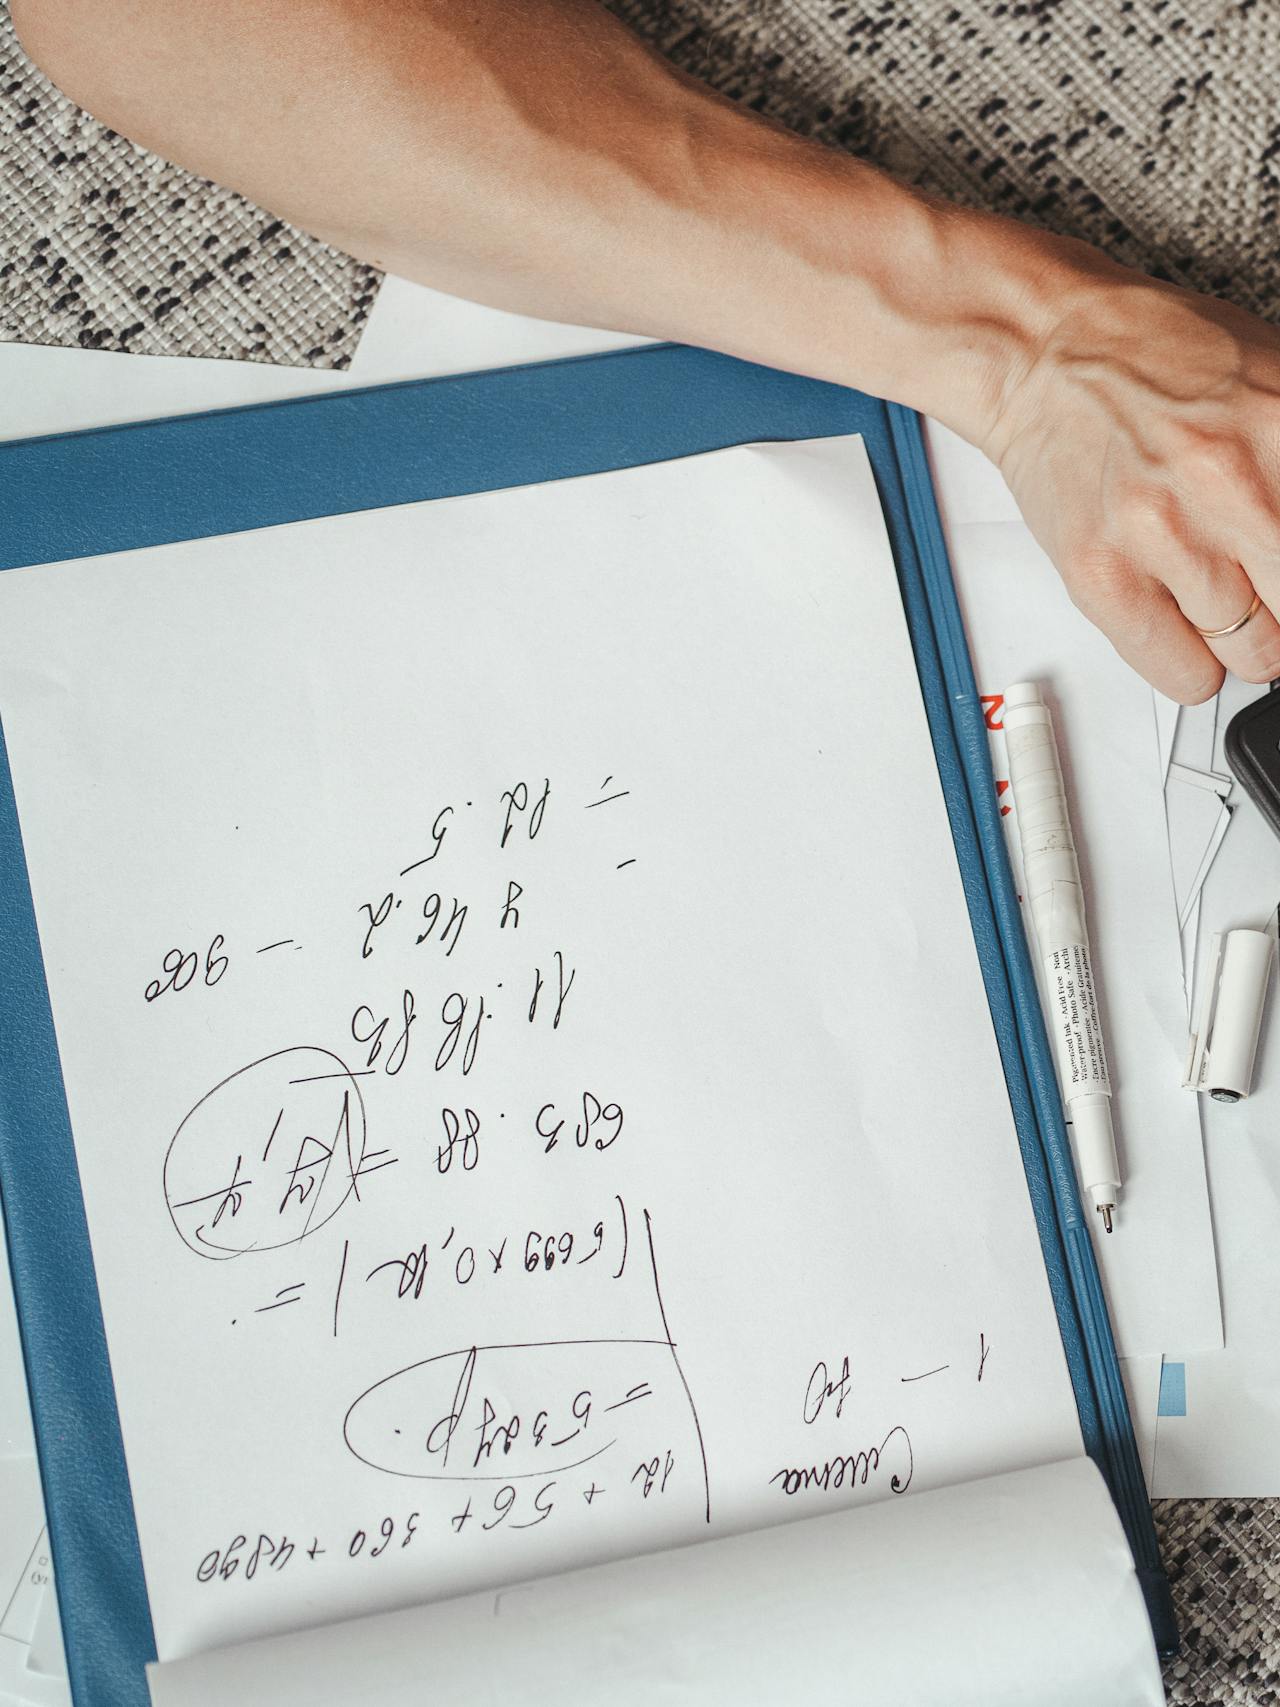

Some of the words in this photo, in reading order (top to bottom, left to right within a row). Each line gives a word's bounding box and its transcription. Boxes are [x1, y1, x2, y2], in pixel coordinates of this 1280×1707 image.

[629, 1448, 676, 1500] 12
[480, 1480, 558, 1532] 56
[347, 1511, 421, 1559] 360
